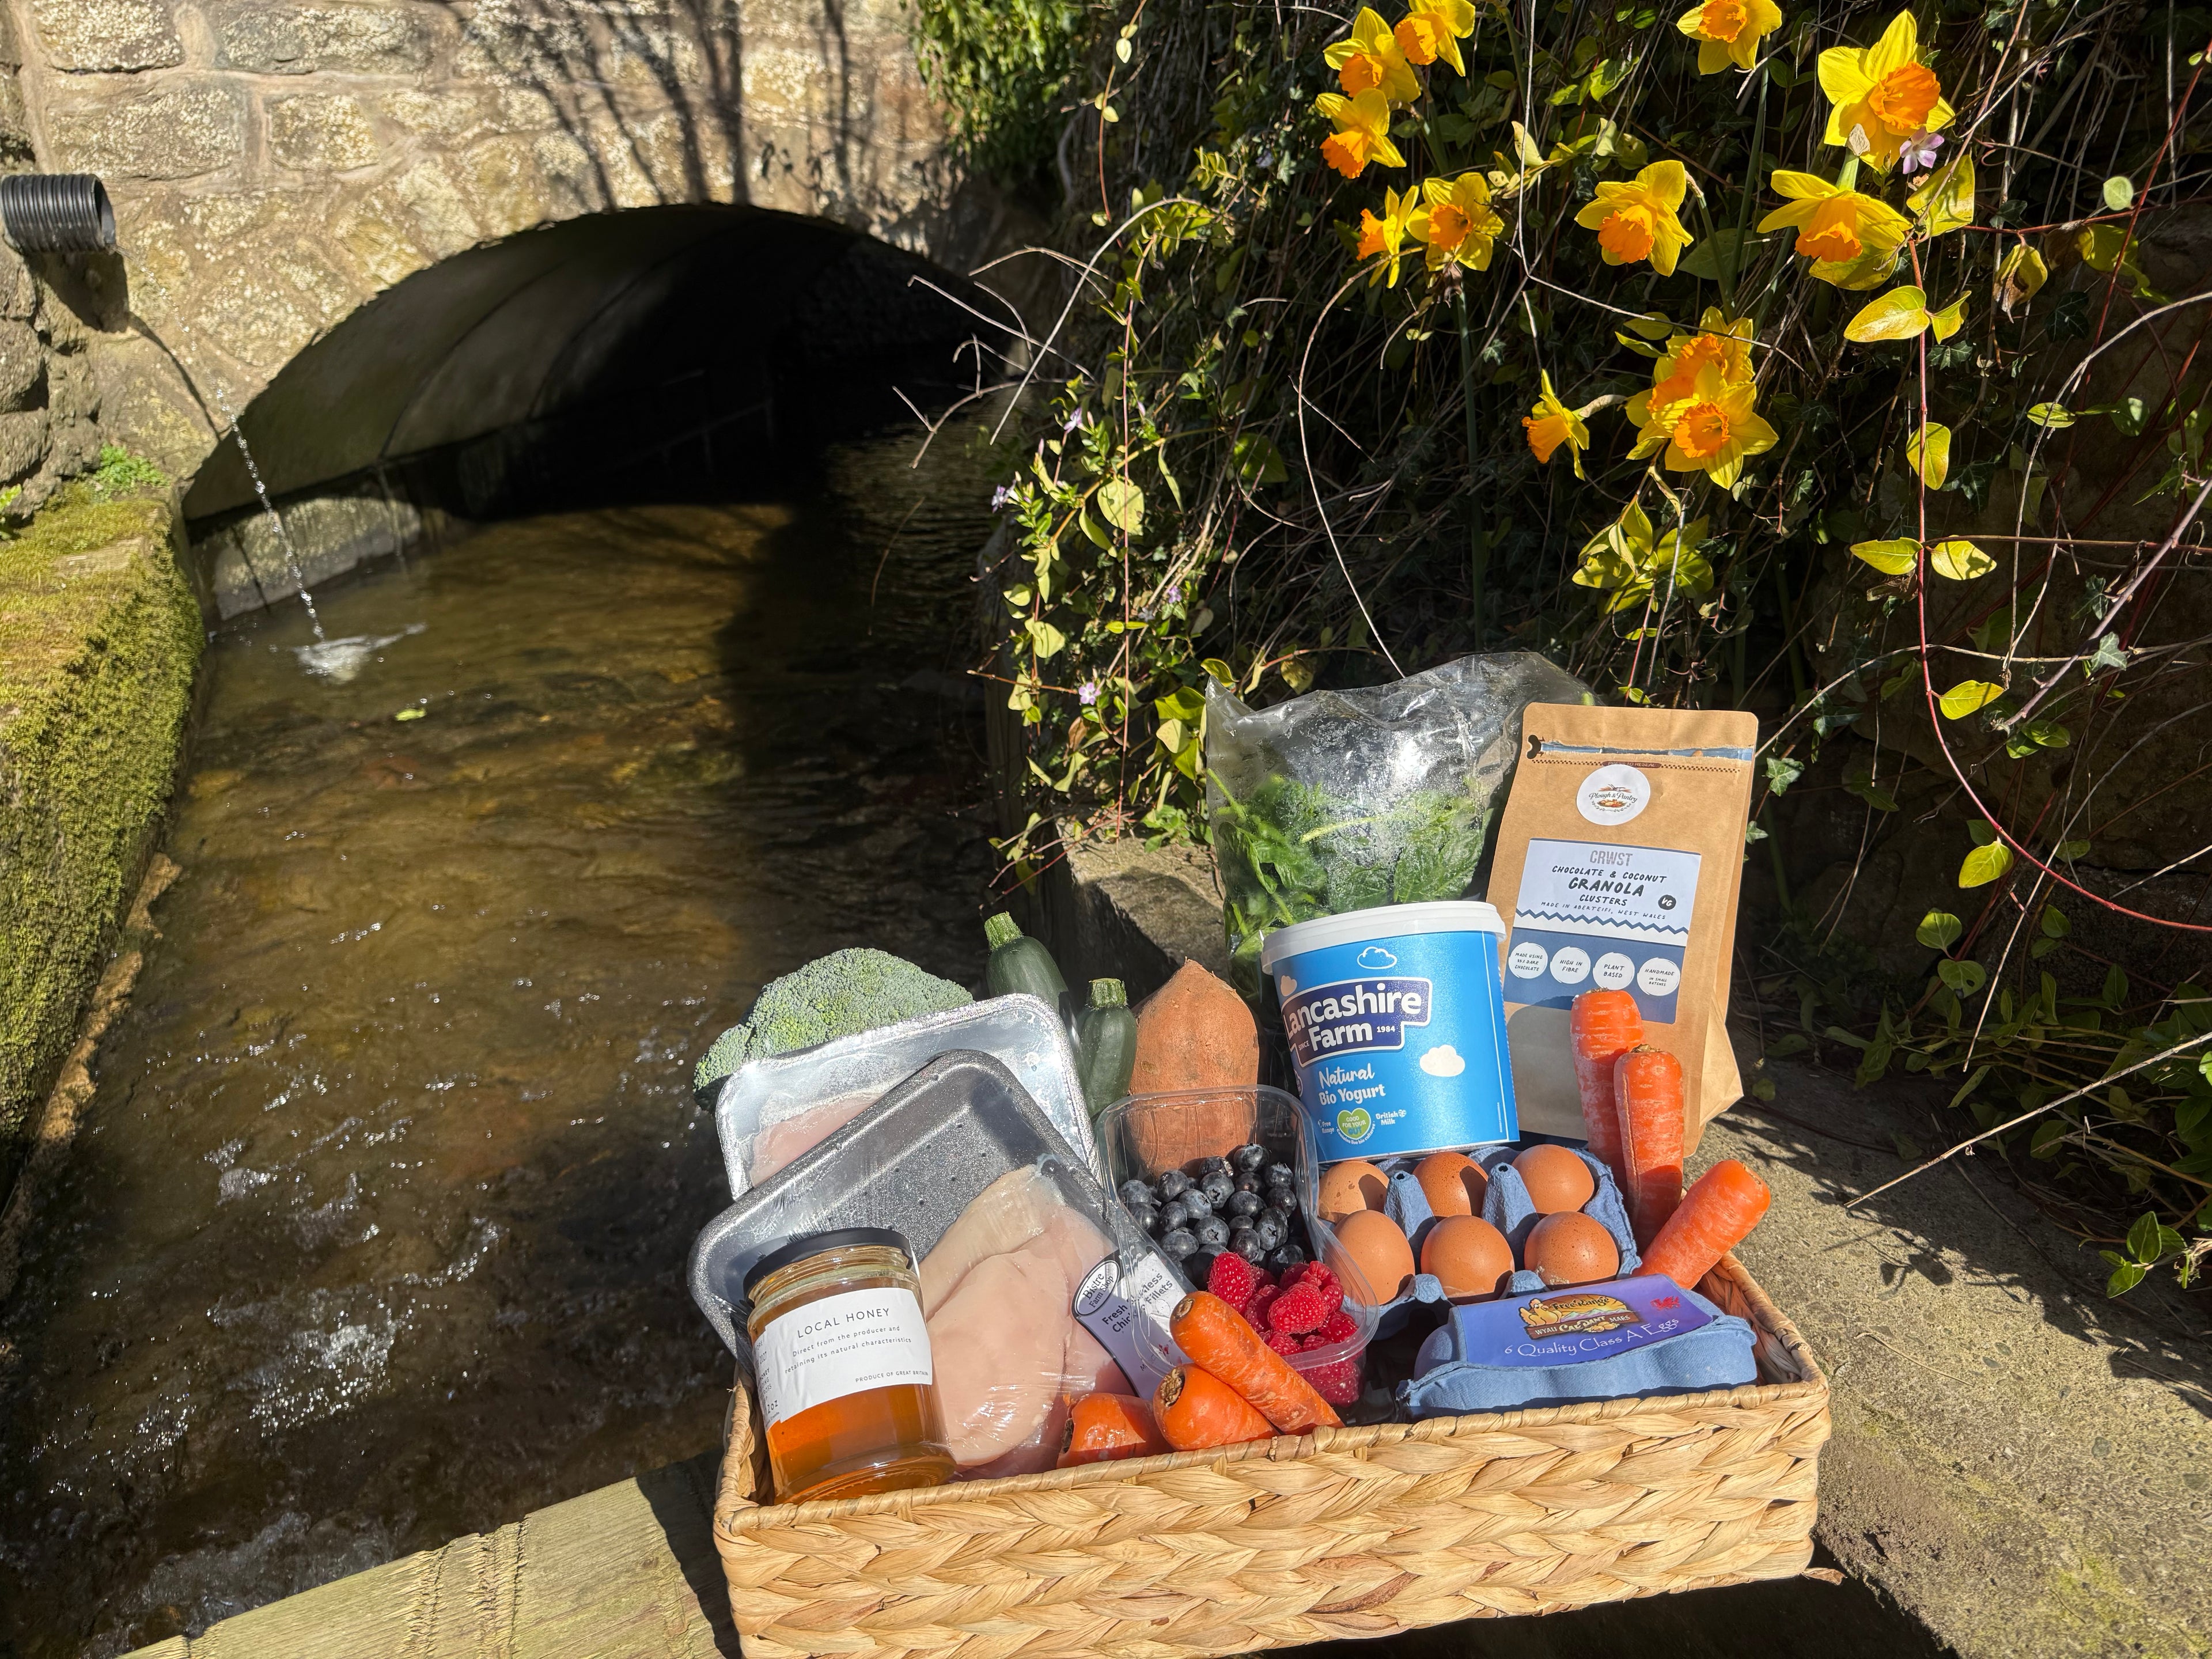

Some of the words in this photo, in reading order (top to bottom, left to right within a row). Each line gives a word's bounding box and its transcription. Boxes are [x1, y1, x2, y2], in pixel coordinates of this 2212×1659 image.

[1616, 793, 1638, 803] Pantry
[1590, 850, 1633, 866] CRWST
[1552, 865, 1604, 876] CHOCOLATE
[1623, 872, 1667, 883] COCONUT
[1568, 877, 1645, 896] GRANOLA
[1573, 905, 1613, 914] ABERTEIFI,
[1580, 895, 1627, 906] CLUSTERS
[1661, 897, 1673, 907] VG
[1283, 983, 1422, 1040] Lancashire
[1298, 1040, 1310, 1051] SINCE
[1308, 1022, 1373, 1051] Farm
[1319, 1063, 1376, 1089] Natural
[1319, 1090, 1337, 1105] Bio
[1338, 1084, 1386, 1104] Yogurt
[1376, 1111, 1399, 1120] British
[1348, 1126, 1362, 1135] GUT
[1083, 1274, 1104, 1300] Bistre
[1089, 1292, 1103, 1308] Farm
[1100, 1276, 1114, 1292] Shop
[1551, 1302, 1575, 1310] Free
[1573, 1296, 1609, 1306] Range
[797, 1317, 840, 1338] LOCAL
[846, 1308, 890, 1323] HONEY
[1102, 1305, 1128, 1325] Fresh
[793, 1344, 814, 1357] Direct
[817, 1338, 835, 1347] from
[838, 1332, 850, 1341] the
[854, 1327, 887, 1338] producer
[1505, 1345, 1513, 1354] 6
[1517, 1342, 1577, 1357] Quality
[1579, 1336, 1622, 1351] Class
[1627, 1329, 1643, 1342] A
[1641, 1318, 1679, 1335] Eggs
[785, 1357, 815, 1374] retaining
[831, 1343, 858, 1355] natural
[861, 1337, 912, 1347] characteristics
[855, 1372, 884, 1382] PRODUCE
